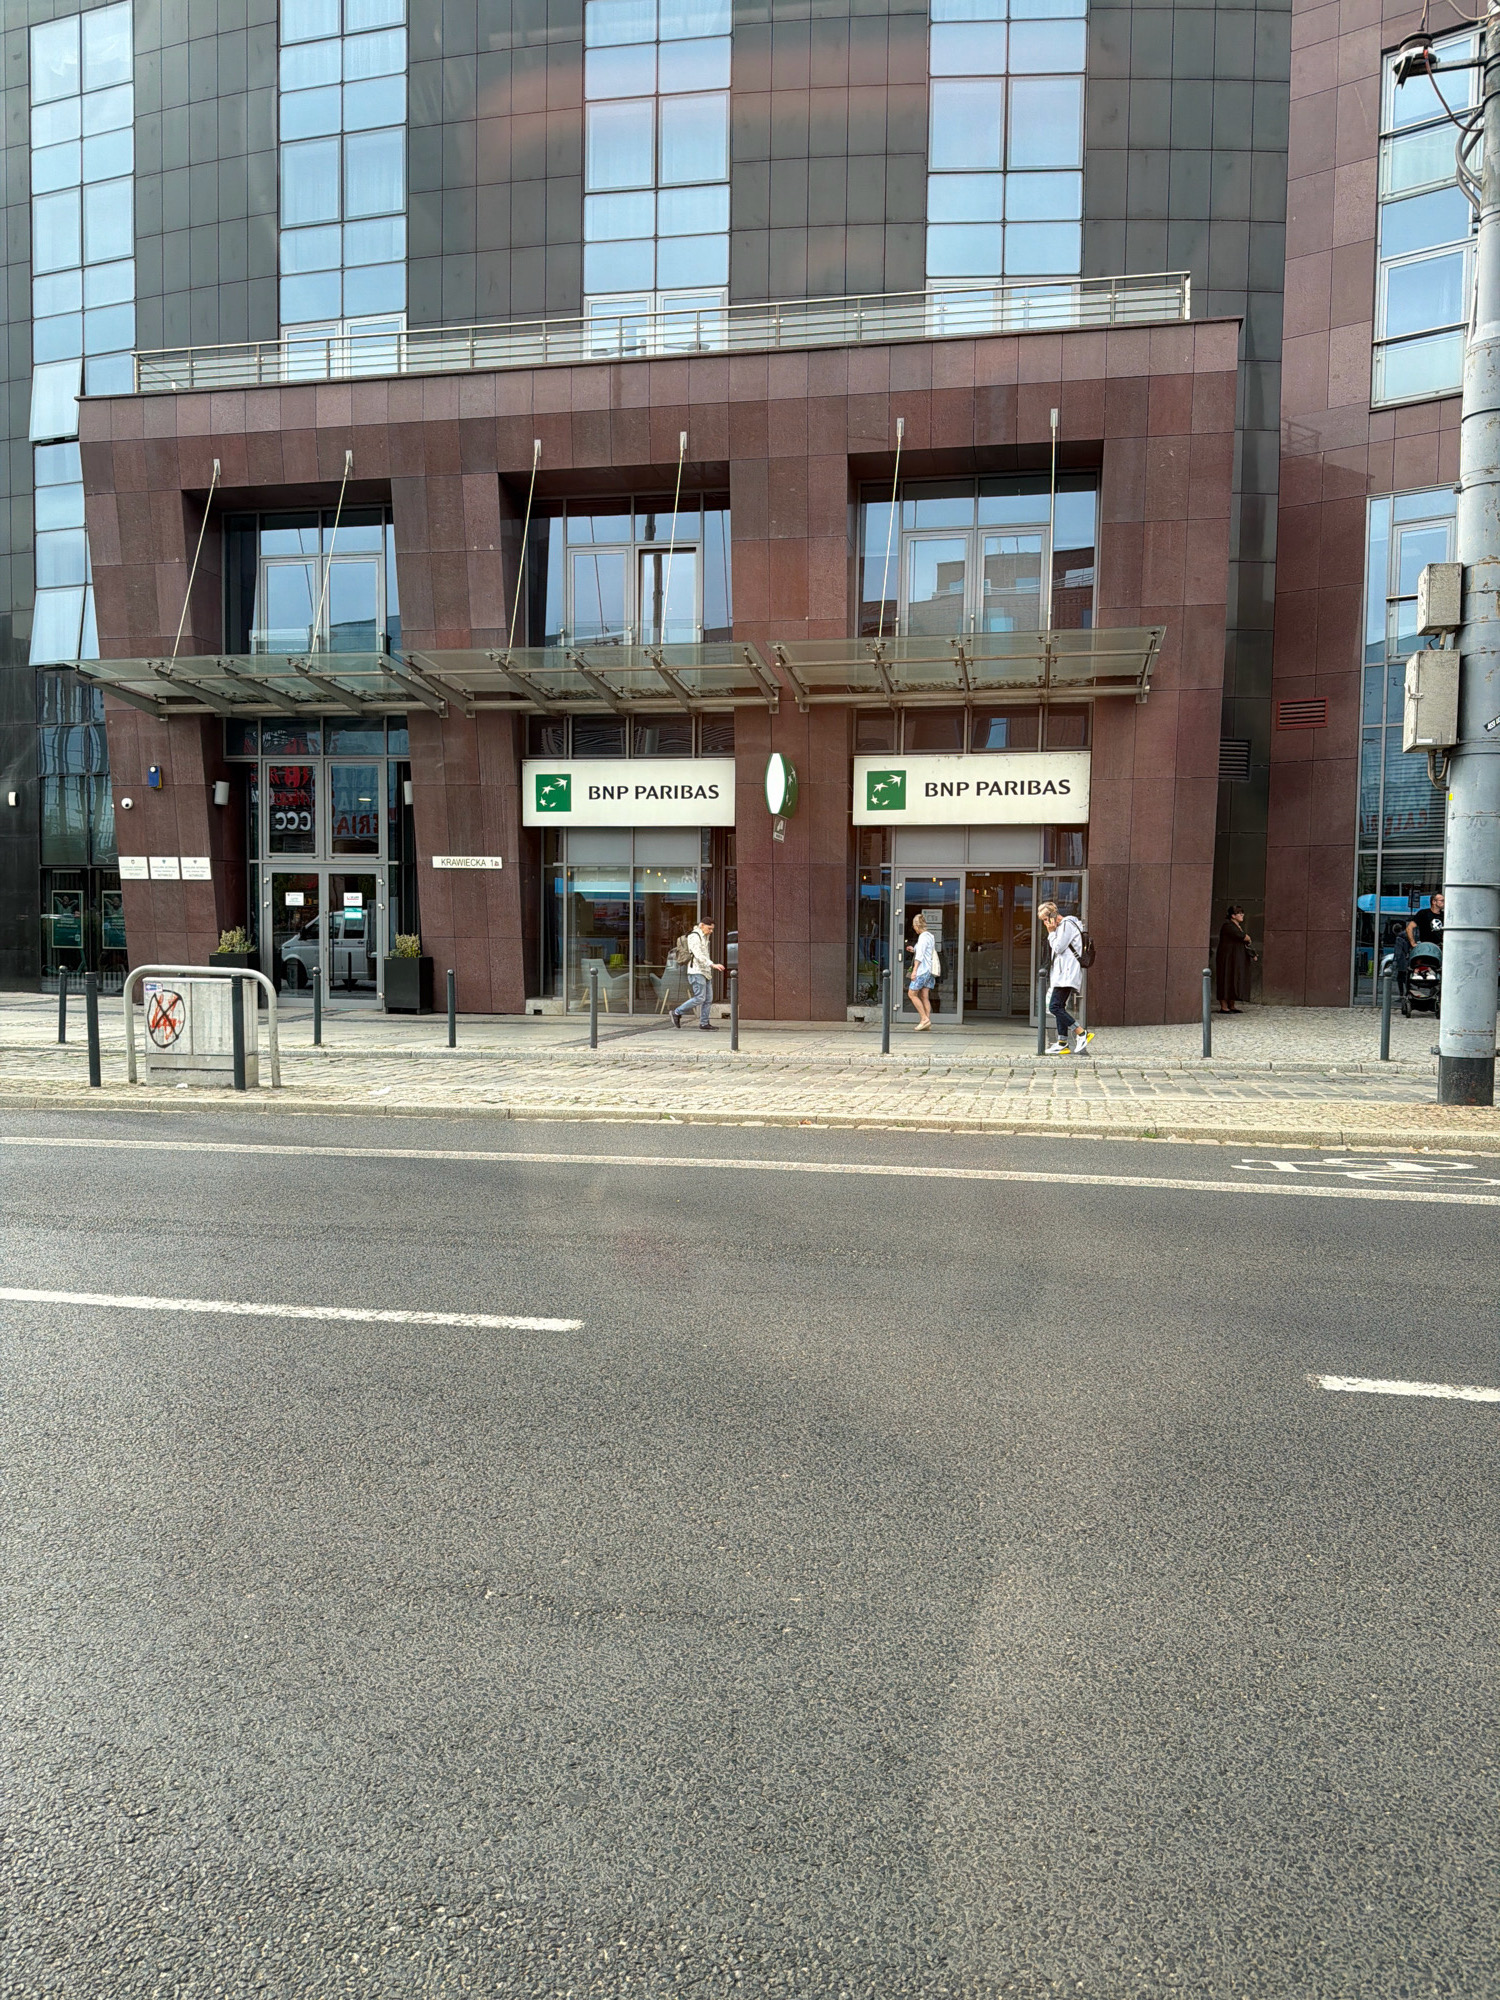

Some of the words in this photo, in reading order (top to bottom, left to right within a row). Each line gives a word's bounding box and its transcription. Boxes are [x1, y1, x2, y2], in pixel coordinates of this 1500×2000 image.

[588, 786, 629, 800] BNP
[634, 784, 719, 800] PARIBAS
[925, 782, 969, 797] BNP
[976, 779, 1071, 796] PARIBAS
[440, 858, 487, 867] KRAWIECKA
